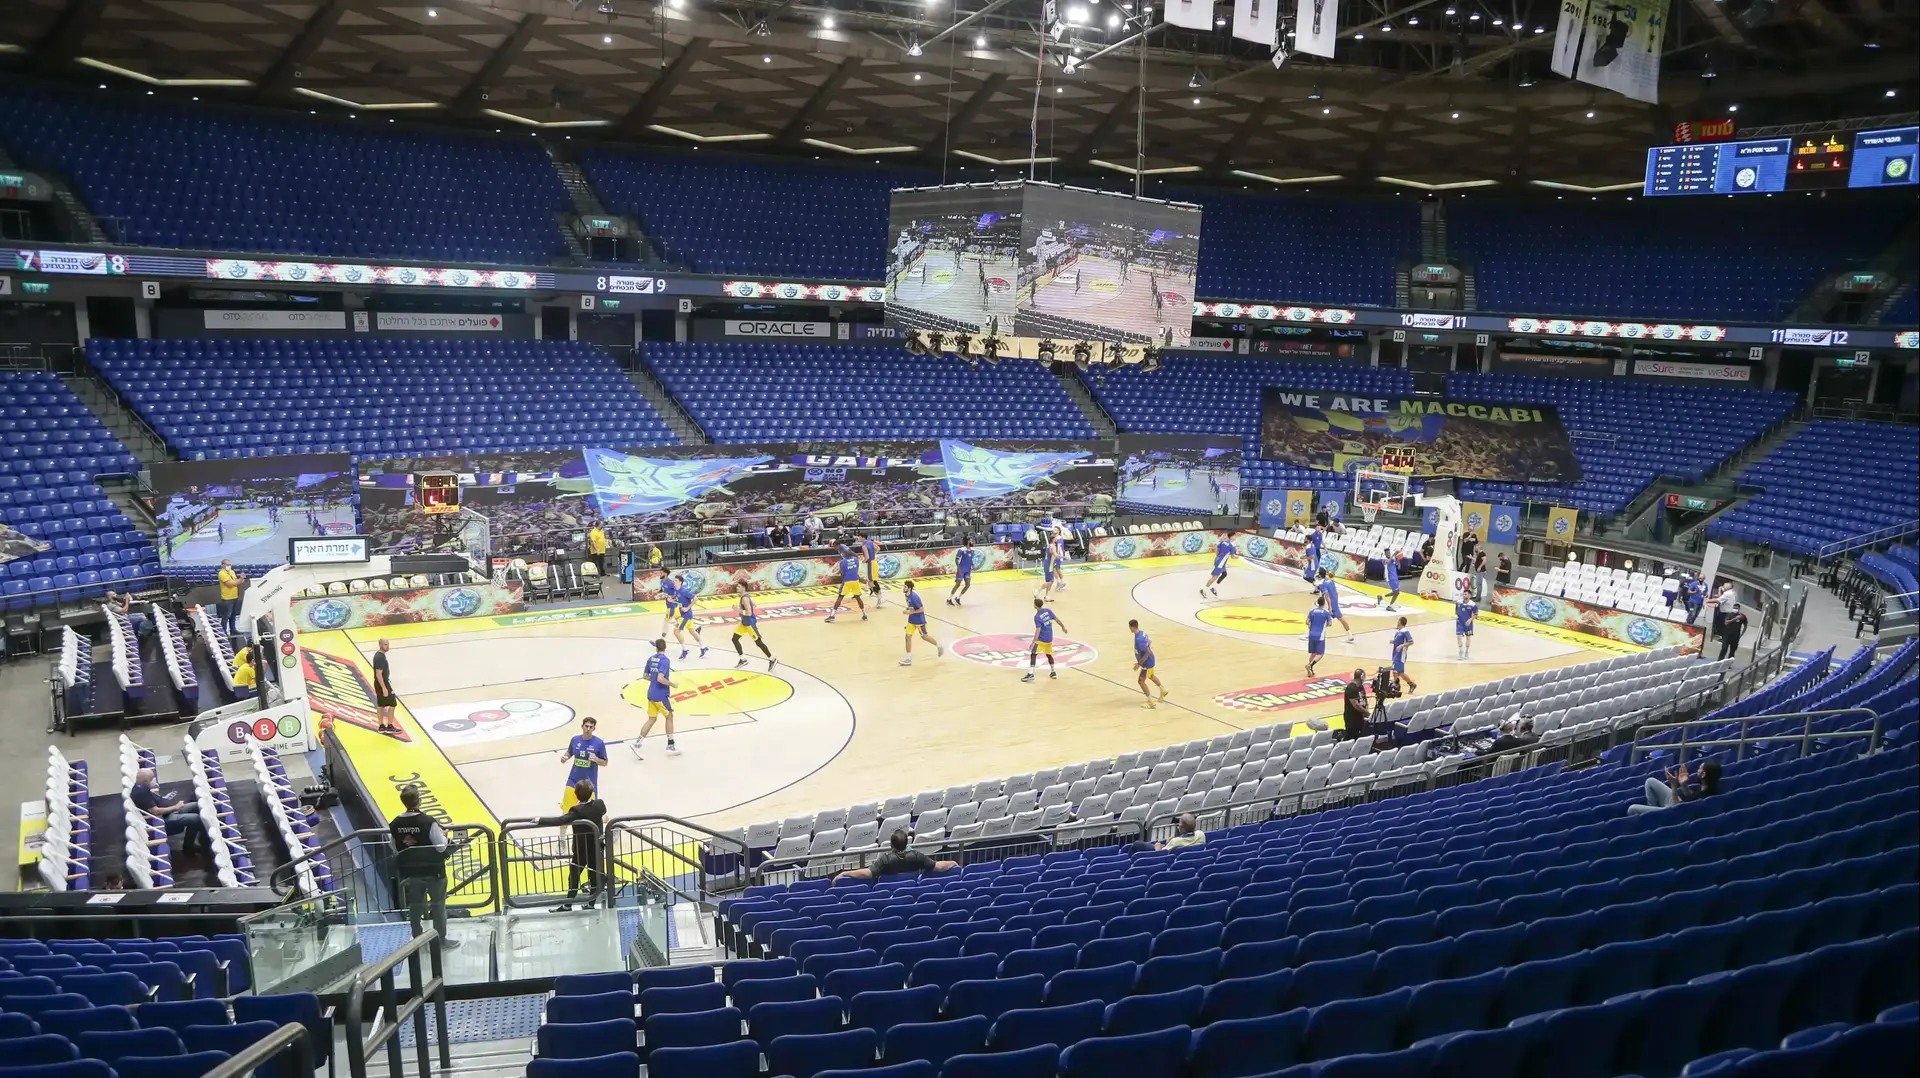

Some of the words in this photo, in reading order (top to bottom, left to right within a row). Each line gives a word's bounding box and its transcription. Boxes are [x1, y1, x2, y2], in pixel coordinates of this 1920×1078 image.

[20, 252, 35, 269] 7
[112, 254, 125, 272] 8
[597, 276, 606, 290] 8
[656, 279, 666, 292] 9
[148, 285, 155, 295] 8
[585, 298, 590, 307] 8
[682, 302, 688, 310] 9
[379, 316, 410, 325] החלטה
[412, 317, 426, 326] בכל
[430, 318, 456, 326] איתכם
[459, 319, 487, 327] פועלים
[1401, 314, 1413, 326] 10
[1455, 316, 1467, 328] 11
[739, 322, 815, 334] ORACLE
[867, 327, 896, 338] מדיה
[1771, 329, 1784, 342] 11
[1832, 331, 1848, 344] 12
[1751, 350, 1760, 358] 11
[1856, 354, 1868, 363] 12
[1637, 363, 1674, 373] weSure
[1708, 367, 1747, 378] weSure
[1279, 392, 1320, 409] WE
[1330, 397, 1388, 412] ARE
[1400, 400, 1542, 422] MACCABI
[297, 545, 323, 555] הארץ
[325, 544, 349, 553] זמרת
[260, 585, 282, 604] SPALDING
[1223, 615, 1304, 624] DHL
[669, 677, 748, 703] DHL
[260, 724, 270, 736] B
[284, 720, 294, 732] B
[235, 727, 245, 739] B
